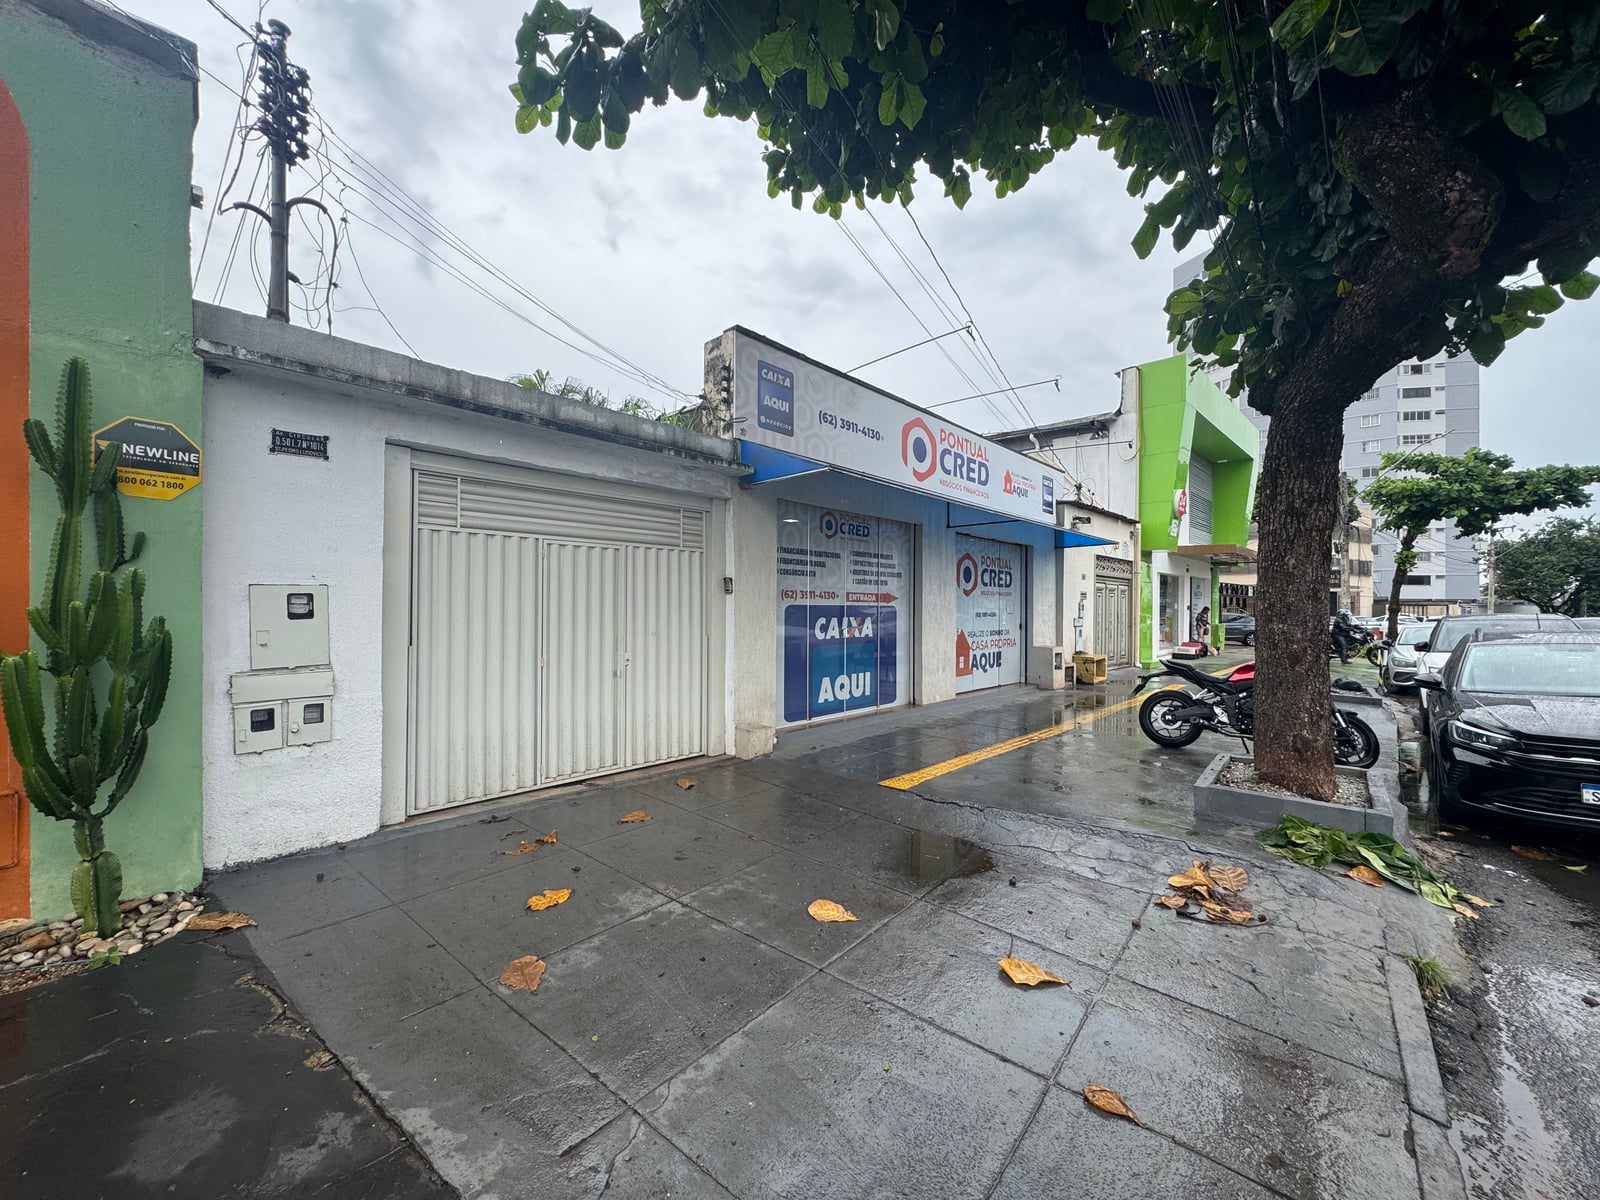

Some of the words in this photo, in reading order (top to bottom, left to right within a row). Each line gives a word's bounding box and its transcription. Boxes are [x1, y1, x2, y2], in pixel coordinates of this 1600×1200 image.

[761, 368, 791, 388] CAIXA
[763, 395, 789, 413] AQUI
[818, 410, 838, 429] (62)
[839, 418, 881, 441] 3911-4130
[288, 432, 325, 442] CIRCULAR
[939, 428, 990, 462] PONTUAL
[122, 443, 199, 463] NEWLINE
[939, 447, 990, 487] CRED
[118, 476, 137, 485] 800
[139, 478, 158, 487] 062
[161, 480, 184, 490] 1800
[839, 522, 870, 537] CRED
[980, 555, 1012, 570] PONTUAL
[980, 568, 1013, 588] CRED
[781, 588, 798, 601] (62)
[848, 593, 877, 602] ENTRADA
[815, 616, 873, 640] CAIXA
[967, 630, 985, 638] REALIZE
[970, 640, 989, 651] CASA
[817, 671, 871, 704] AQUI
